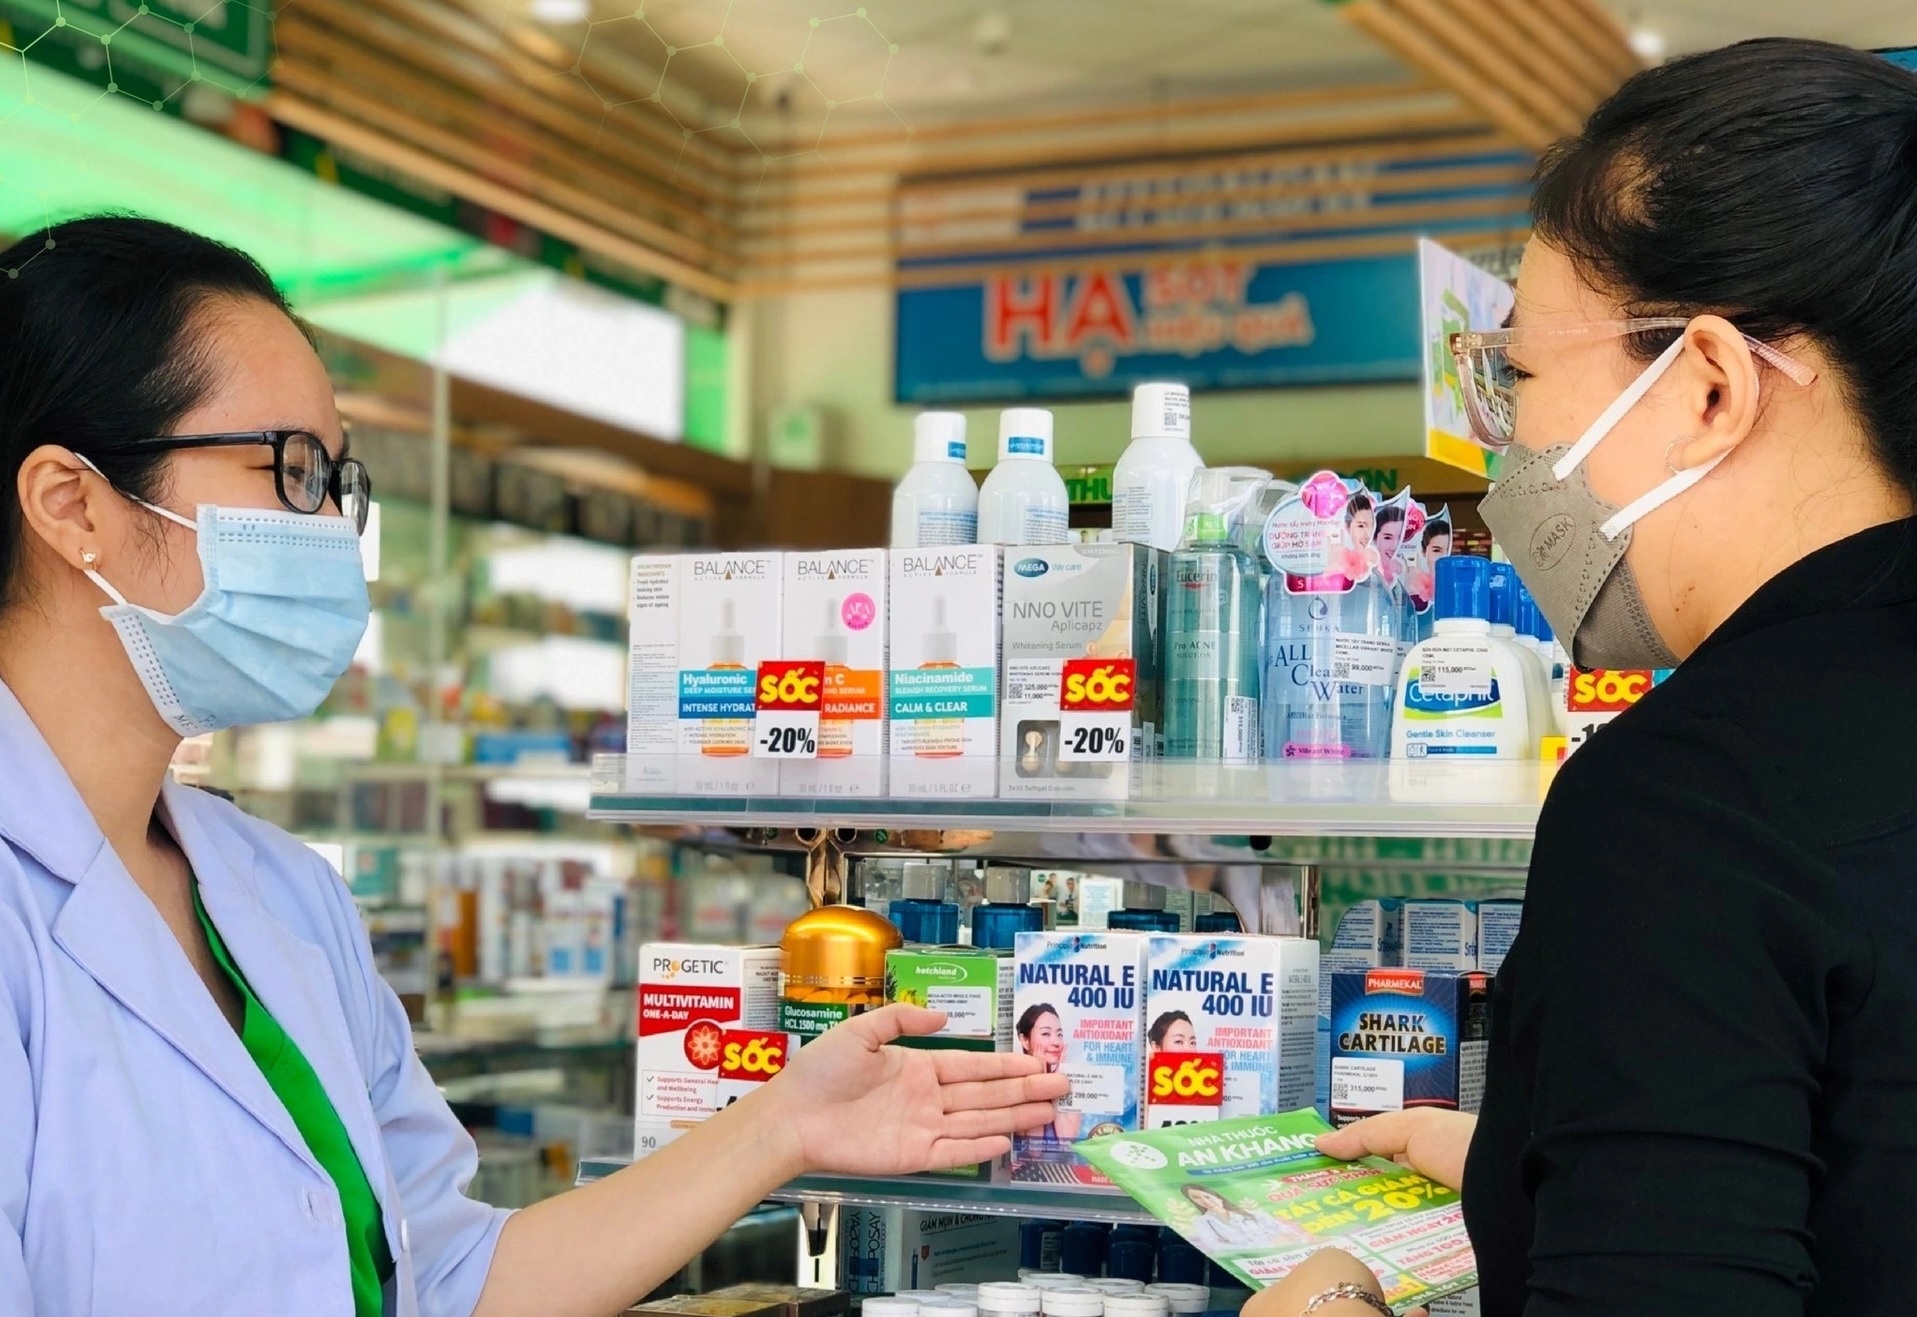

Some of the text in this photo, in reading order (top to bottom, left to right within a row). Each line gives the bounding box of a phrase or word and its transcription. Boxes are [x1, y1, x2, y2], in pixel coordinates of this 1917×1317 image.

[694, 559, 767, 576] BALANCE
[798, 558, 869, 576] BALANCE
[903, 554, 977, 573] BALANCE
[1018, 563, 1045, 572] MEGA
[1176, 570, 1218, 583] Eucerin
[1013, 601, 1103, 619] NNO VITE
[1051, 620, 1103, 633] Aplicapz
[1012, 640, 1082, 652] Whitening Serum
[1189, 640, 1216, 650] ACNE
[1275, 644, 1312, 668] ALL
[683, 673, 748, 688] Hyaluronic
[835, 673, 845, 685] C
[895, 671, 974, 685] Niacinamide
[1065, 664, 1132, 703] SỐC
[684, 686, 746, 694] DEEP MOISTURE
[759, 667, 820, 704] SỐC
[839, 687, 866, 695] SERUM
[925, 685, 962, 693] RECOVERY
[963, 684, 988, 692] SERUM
[1310, 680, 1365, 702] Water
[683, 703, 719, 713] INTENSE
[825, 703, 876, 713] RADIANCE
[895, 702, 923, 713] CALM
[934, 701, 968, 712] CLEAR
[760, 727, 816, 754] -20%
[1065, 727, 1125, 754] -20%
[1406, 729, 1496, 739] Gentle Skin Cleanser
[653, 957, 724, 975] PROGETIC
[1020, 963, 1134, 986] NATURAL E
[1153, 969, 1274, 994] NATURAL E
[1368, 978, 1423, 989] PHARMEKAL
[643, 993, 735, 1010] MULTIVITAMIN
[1067, 986, 1134, 1009] 400 IU
[785, 1005, 843, 1019] Glucosamine
[1202, 994, 1273, 1017] 400 IU
[643, 1009, 690, 1020] ONE-A-DAY
[1080, 1020, 1134, 1030] IMPORTANT
[1359, 1012, 1426, 1033] SHARK
[1073, 1030, 1134, 1040] ANTIOXIDANT
[1215, 1027, 1273, 1039] IMPORTANT
[1083, 1041, 1133, 1053] FOR HEART
[1207, 1039, 1273, 1050] ANTIOXIDANT
[1339, 1033, 1447, 1055] CARTILAGE
[721, 1036, 784, 1074] SỐC
[1086, 1052, 1133, 1063] & IMMUNE
[1240, 1051, 1273, 1062] HEART
[1231, 1062, 1273, 1073] IMMUNE
[657, 1076, 682, 1084] Supports
[1152, 1057, 1220, 1097] SỐC
[668, 1086, 697, 1094] Wellbeing
[657, 1095, 703, 1104] Supports Energy
[642, 1136, 656, 1149] 90
[1188, 1125, 1278, 1148] NHÀ THUỐC
[1178, 1132, 1316, 1168] AN KHANG
[1274, 1174, 1429, 1221] TẤT CẢ GIẢM
[1353, 1183, 1451, 1222] 20%
